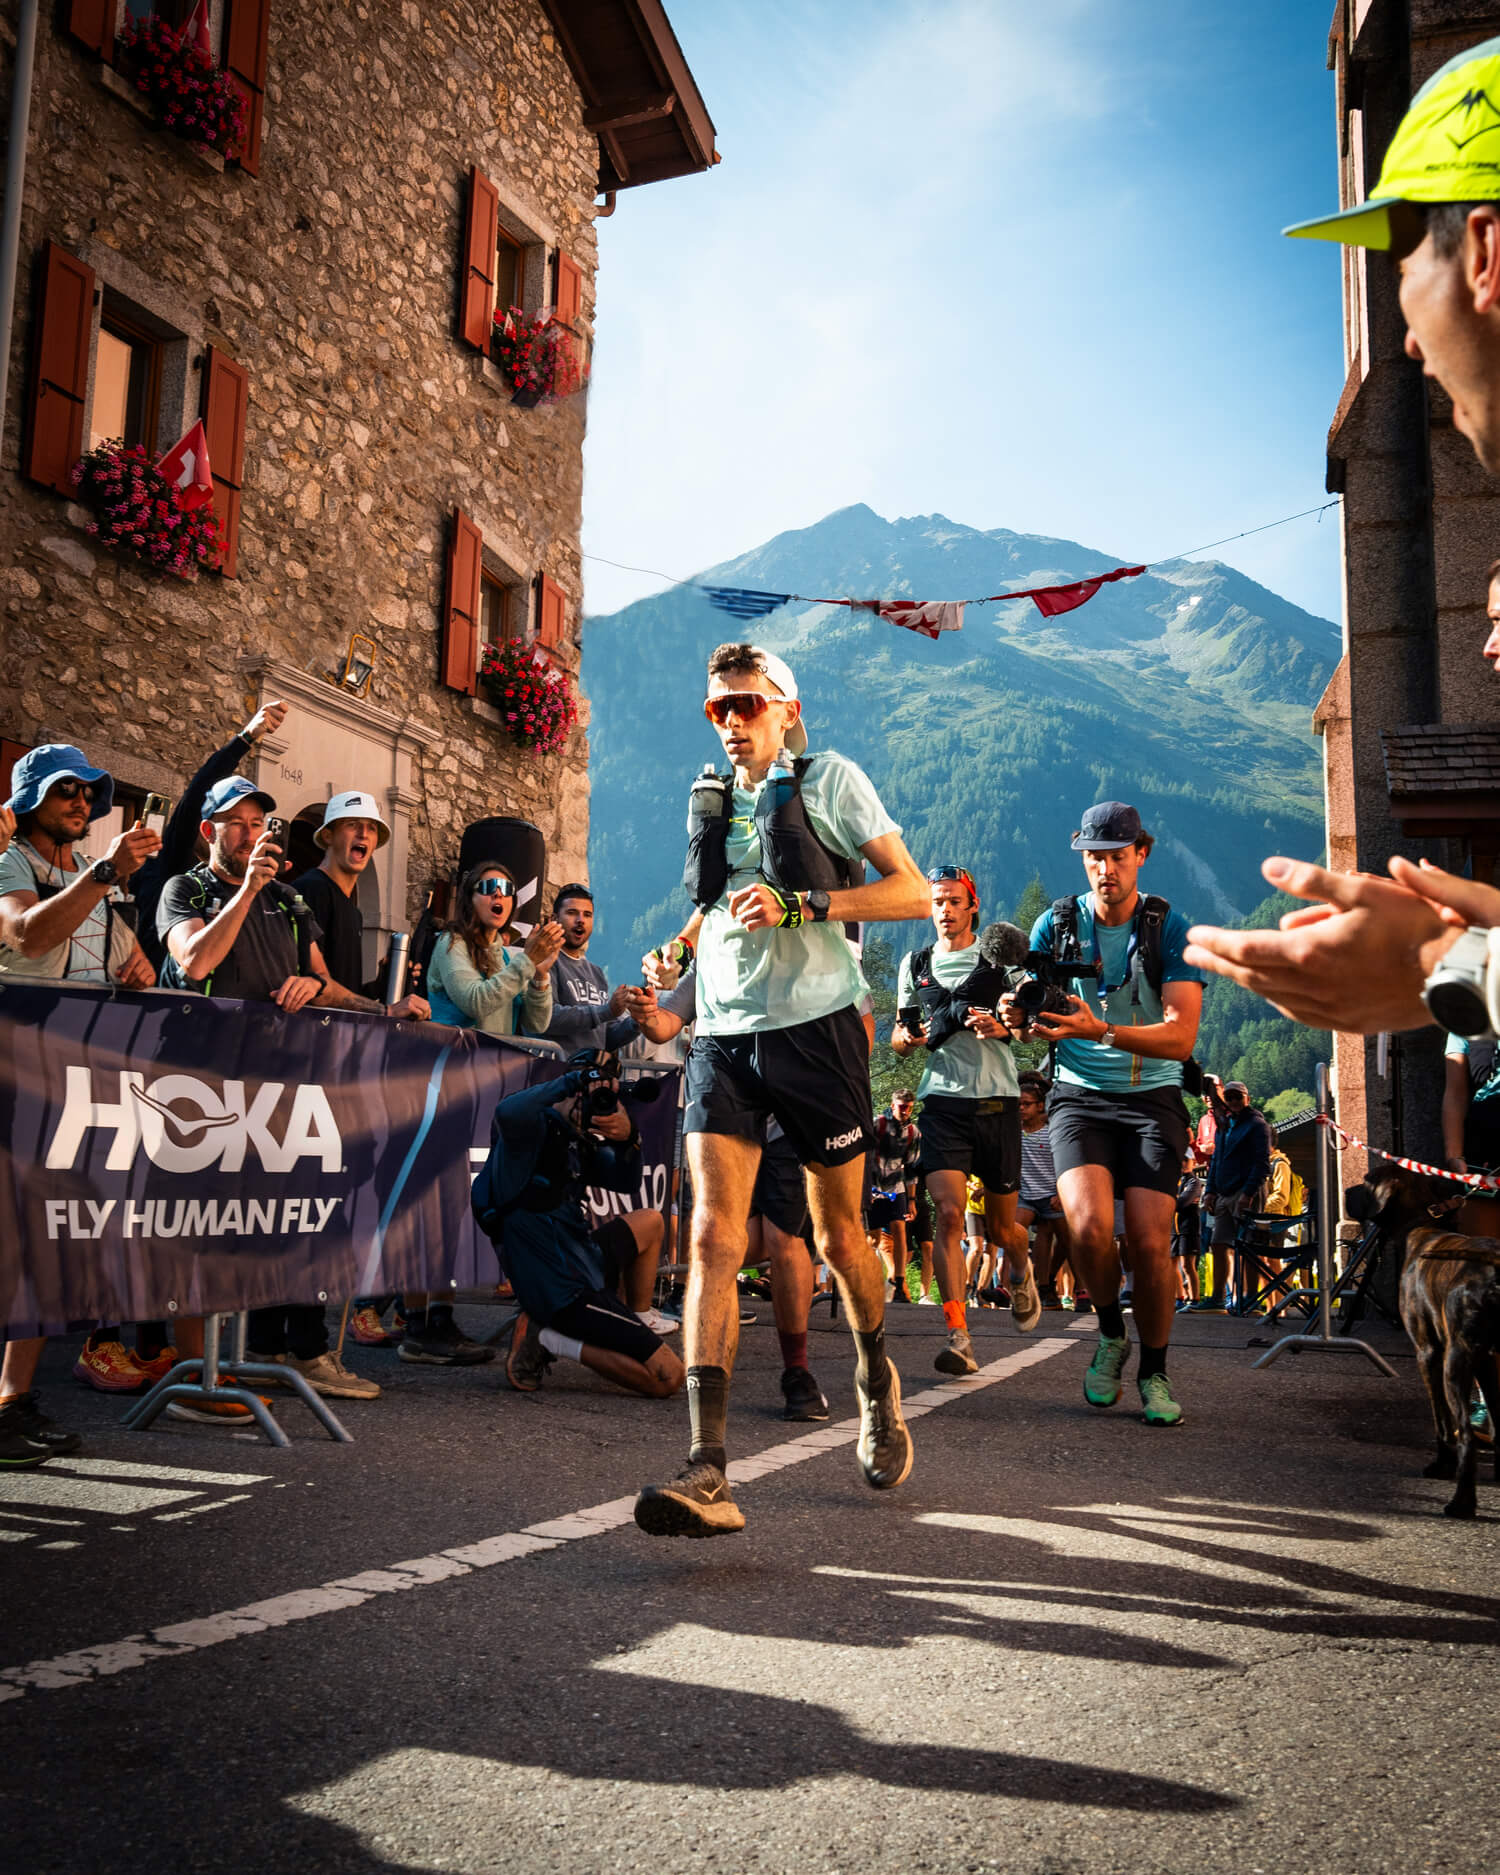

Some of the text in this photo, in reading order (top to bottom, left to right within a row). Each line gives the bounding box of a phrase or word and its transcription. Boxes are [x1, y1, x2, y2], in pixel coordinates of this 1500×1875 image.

[280, 765, 303, 785] 1648
[45, 1065, 343, 1173] HOKA
[825, 1125, 863, 1150] HOKA
[45, 1198, 340, 1239] FLY HUMAN FLY
